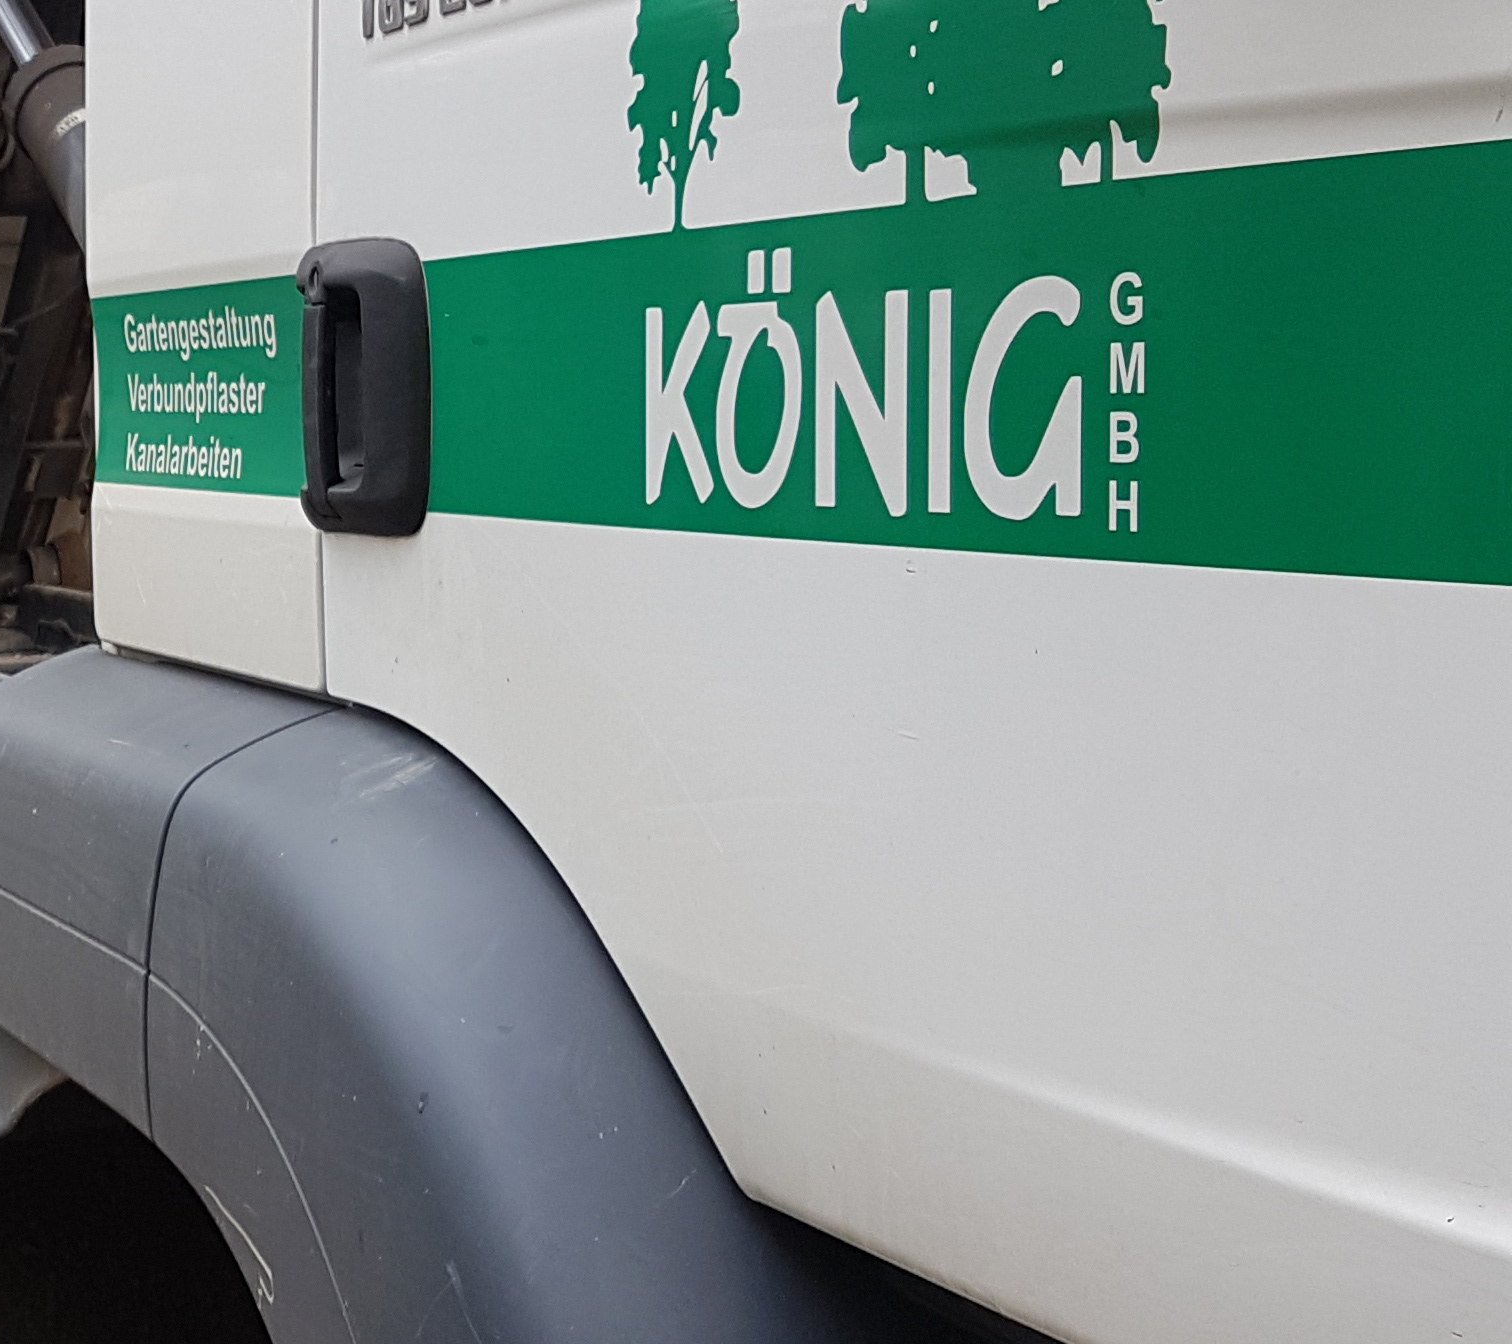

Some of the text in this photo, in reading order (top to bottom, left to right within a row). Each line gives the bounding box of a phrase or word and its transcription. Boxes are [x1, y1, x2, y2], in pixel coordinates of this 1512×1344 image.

[124, 305, 278, 361] Gartengestaltung
[127, 371, 266, 424] Verbundpflaster
[645, 246, 1083, 522] KÖNIG
[1107, 271, 1146, 533] GMBH
[125, 432, 243, 479] Kanalarbeiten
